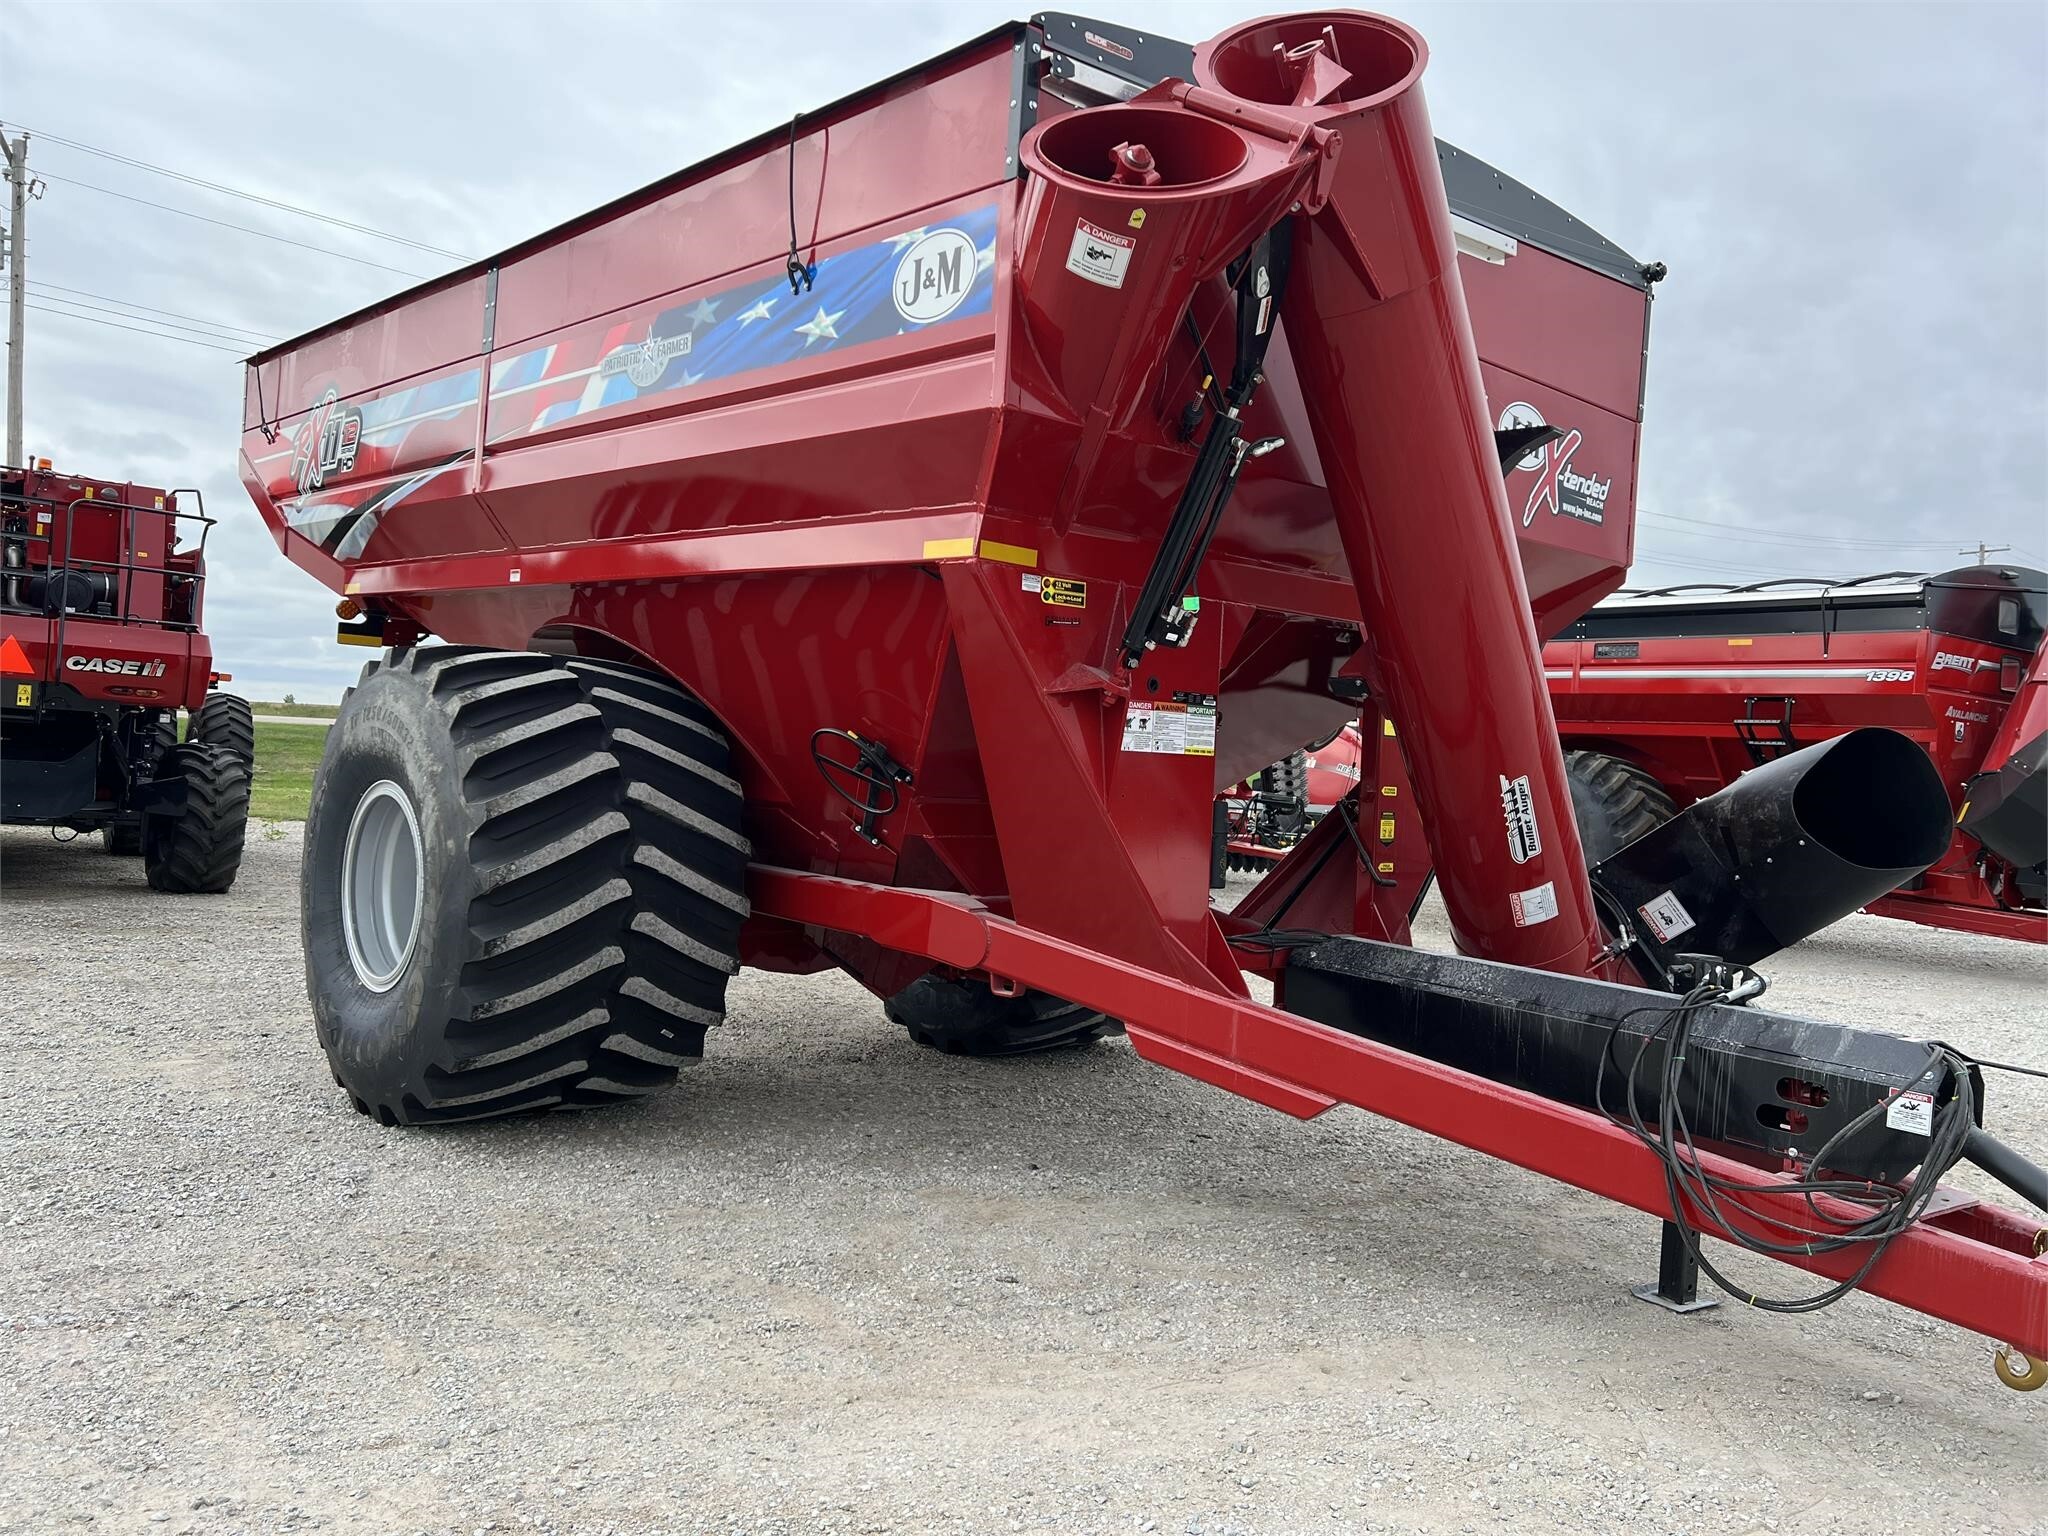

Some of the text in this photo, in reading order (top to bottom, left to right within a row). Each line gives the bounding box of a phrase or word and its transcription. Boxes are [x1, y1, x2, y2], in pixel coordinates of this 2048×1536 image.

[1092, 228, 1128, 247] DANGER
[902, 245, 964, 307] J&M
[603, 336, 689, 374] PATRIOTIC FARMER
[1586, 496, 1604, 510] REACH
[66, 656, 142, 676] CASE
[1866, 670, 1915, 682] 1398
[1128, 701, 1152, 710] DANGER
[1161, 704, 1185, 713] WARNING
[1187, 706, 1216, 716] IMPORTANT
[1945, 705, 1990, 723] AVALANCHE
[1518, 782, 1537, 852] Bullet Auger
[1512, 894, 1525, 921] DANGER
